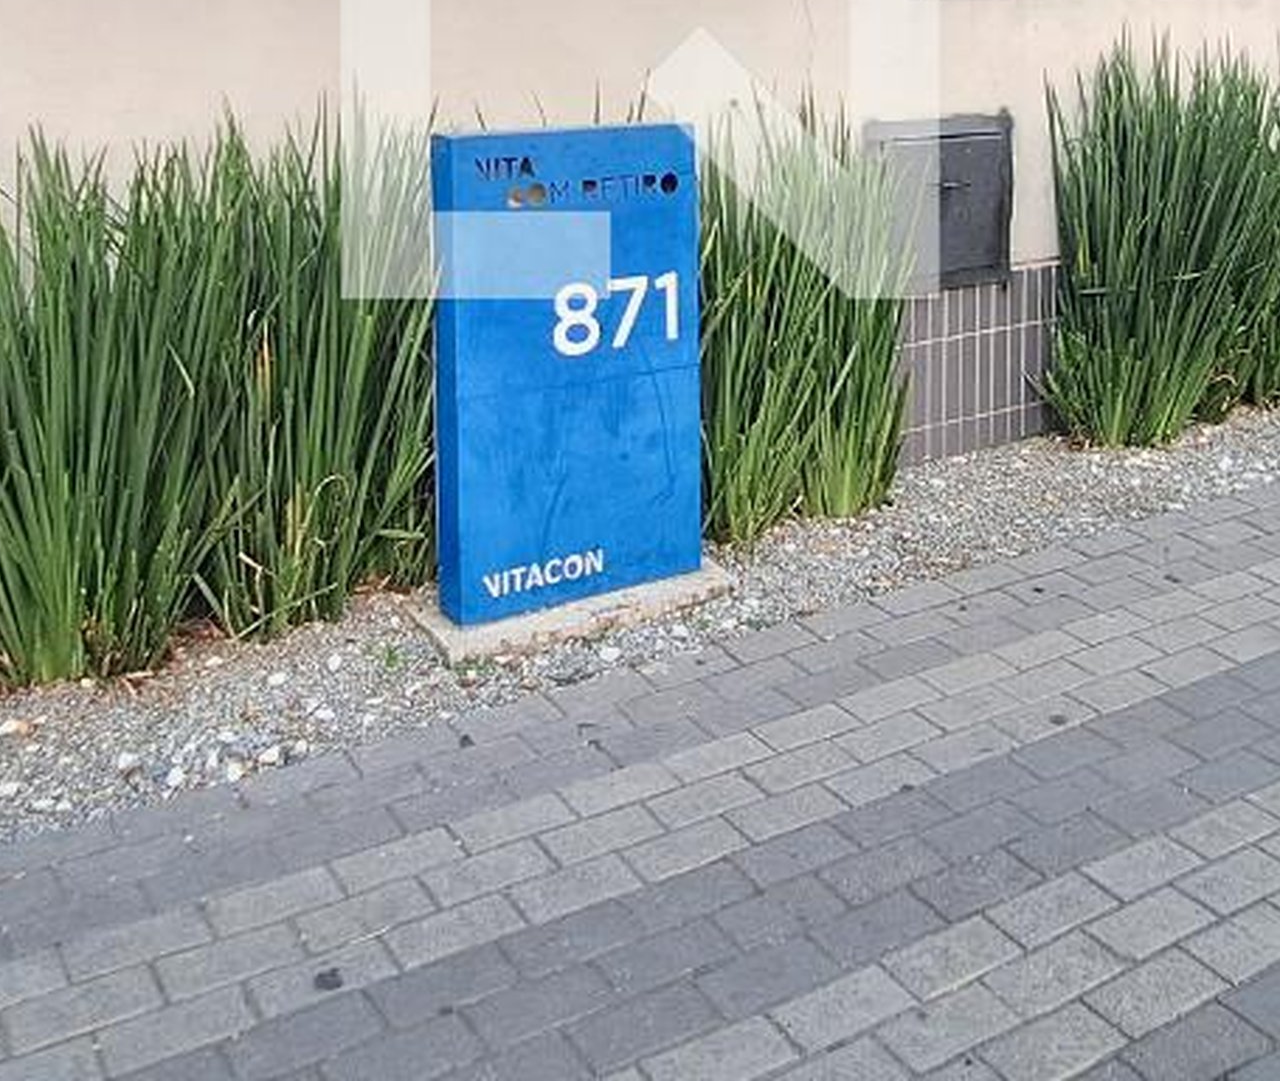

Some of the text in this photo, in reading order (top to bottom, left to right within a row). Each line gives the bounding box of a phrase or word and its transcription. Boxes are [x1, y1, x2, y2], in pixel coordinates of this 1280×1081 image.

[474, 156, 536, 181] VITA
[553, 270, 679, 356] 871
[483, 548, 604, 598] VITACON
